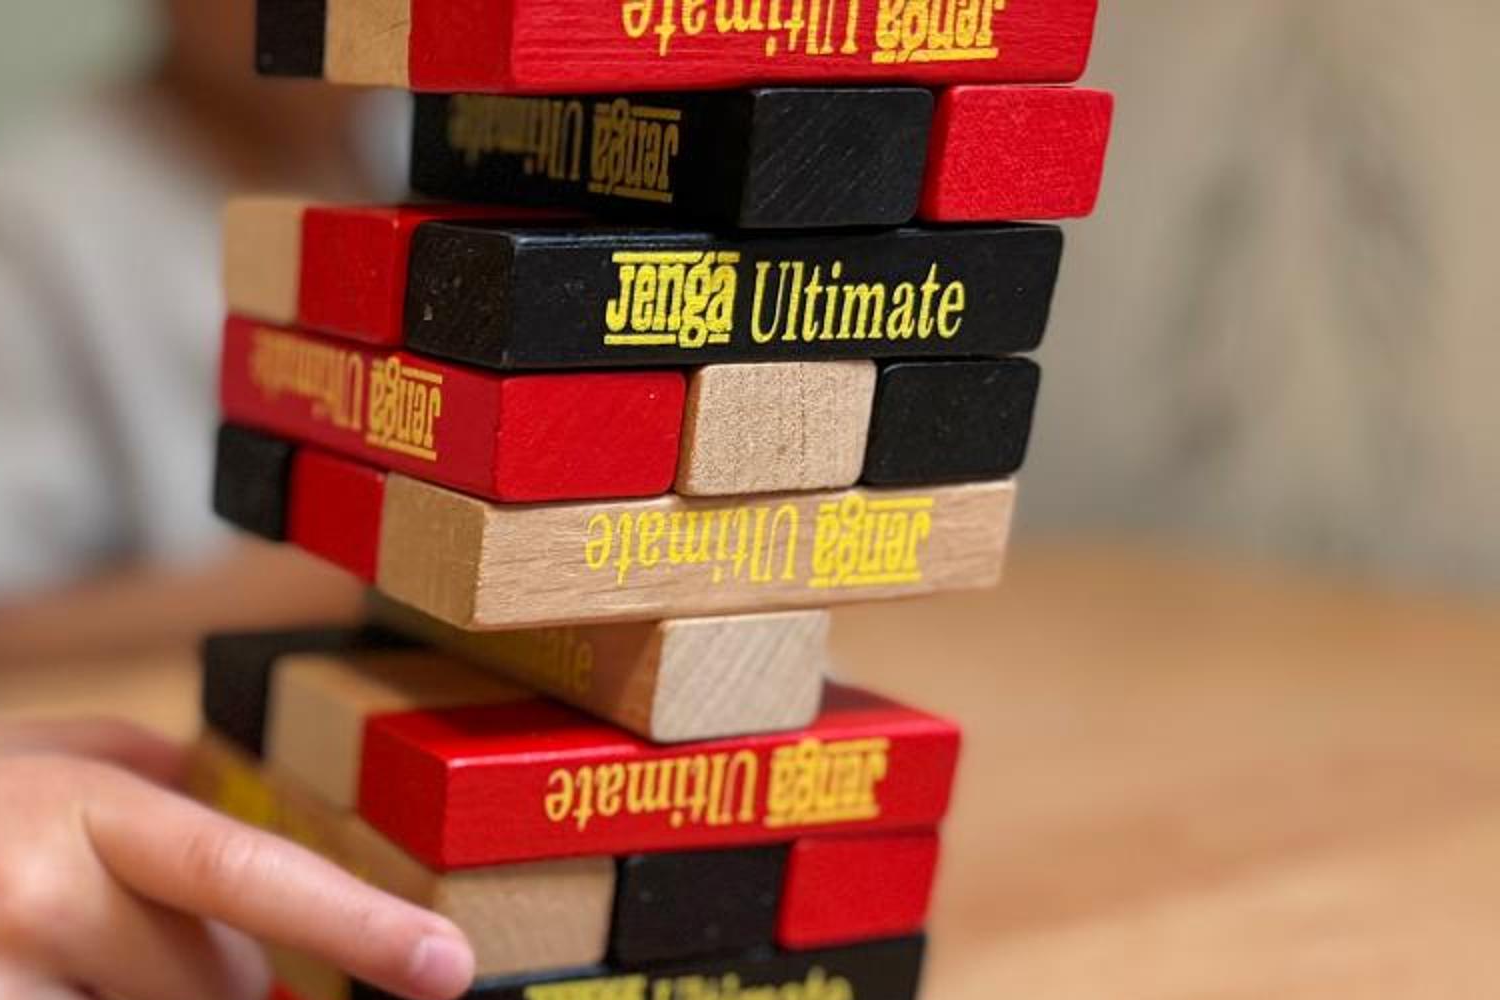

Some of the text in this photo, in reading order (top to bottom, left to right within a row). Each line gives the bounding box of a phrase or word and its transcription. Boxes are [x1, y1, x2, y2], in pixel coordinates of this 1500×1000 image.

[587, 97, 682, 203] Jenga
[604, 251, 966, 348] Jenga Ultimate
[366, 356, 443, 461] Jenga
[585, 495, 934, 587] Jenga Ultimate
[544, 737, 890, 831] Jenga Ultimate
